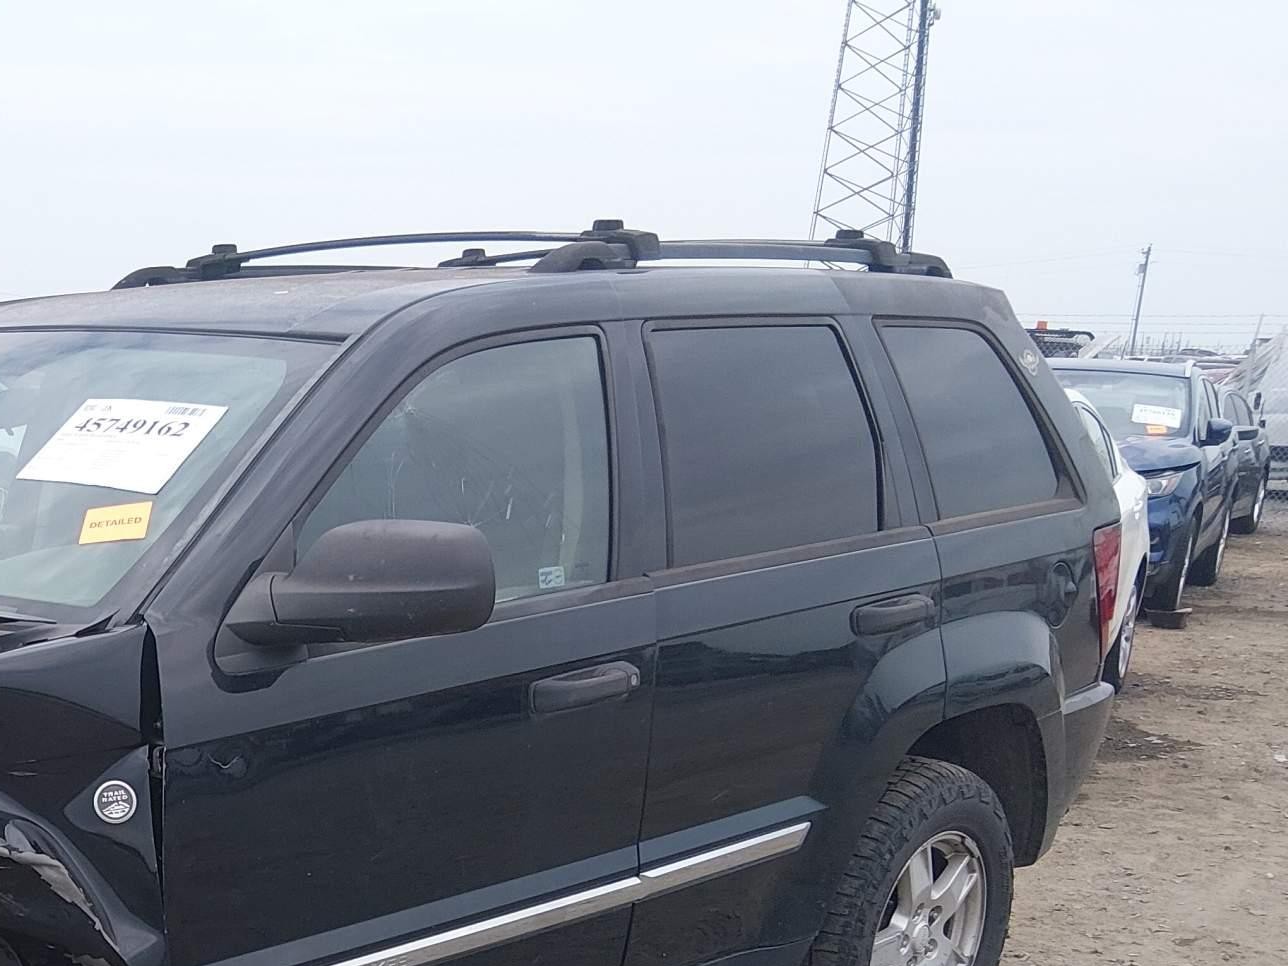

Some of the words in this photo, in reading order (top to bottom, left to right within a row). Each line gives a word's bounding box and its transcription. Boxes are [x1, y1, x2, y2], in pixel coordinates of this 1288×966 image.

[75, 416, 190, 437] 45749162
[88, 516, 143, 530] DETAILED
[101, 795, 128, 803] RATED
[102, 789, 126, 798] TRAIL
